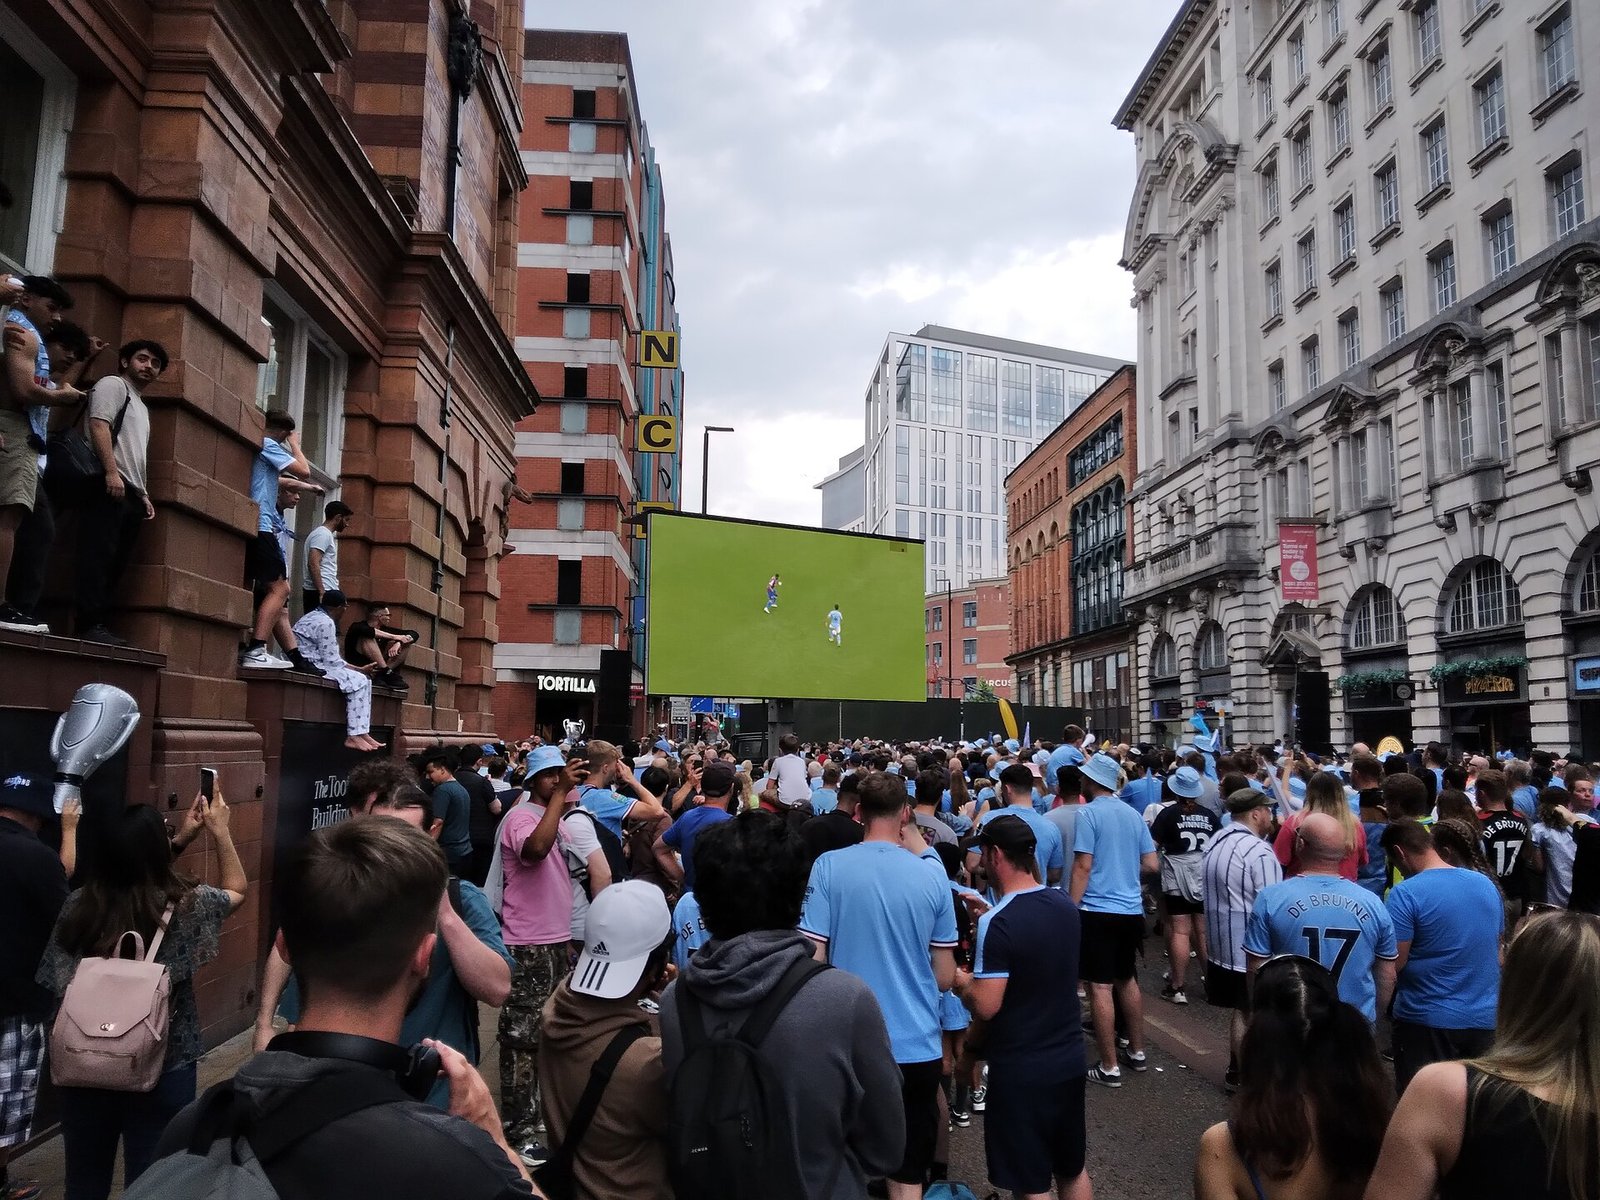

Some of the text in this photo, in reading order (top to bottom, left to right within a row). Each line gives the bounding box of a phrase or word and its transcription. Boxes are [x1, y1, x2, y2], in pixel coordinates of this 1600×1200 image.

[537, 675, 596, 693] TORTILLA
[314, 780, 328, 799] The
[1176, 821, 1213, 831] WINNERS
[1180, 814, 1209, 823] TREBLE
[1482, 825, 1496, 839] DE
[1493, 840, 1524, 877] 17
[1287, 893, 1371, 924] DE BRUYNE
[681, 921, 695, 941] DE
[1301, 926, 1362, 985] 17
